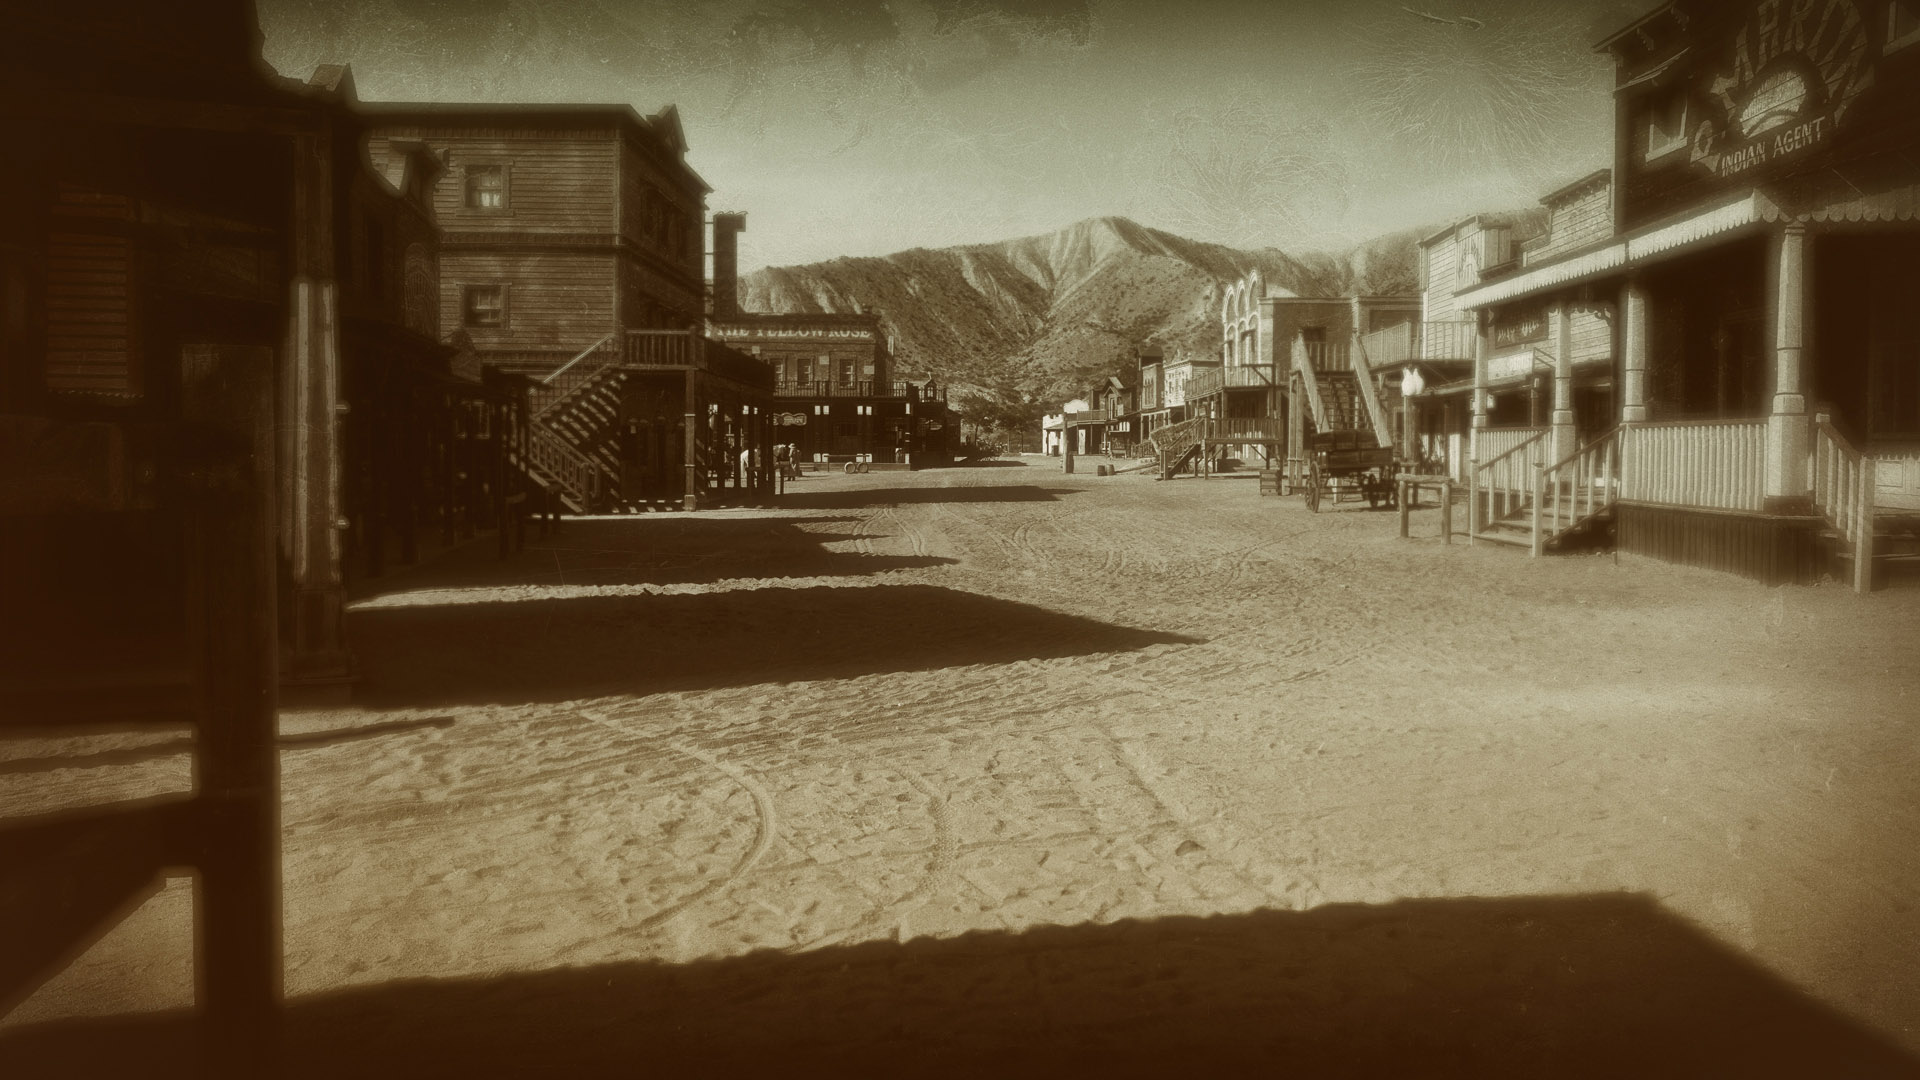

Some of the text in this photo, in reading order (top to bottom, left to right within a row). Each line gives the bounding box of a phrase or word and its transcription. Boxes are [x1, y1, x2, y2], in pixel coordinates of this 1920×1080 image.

[1722, 115, 1827, 177] INDIAN AGENT
[716, 324, 872, 339] THE YELLOW ROSE
